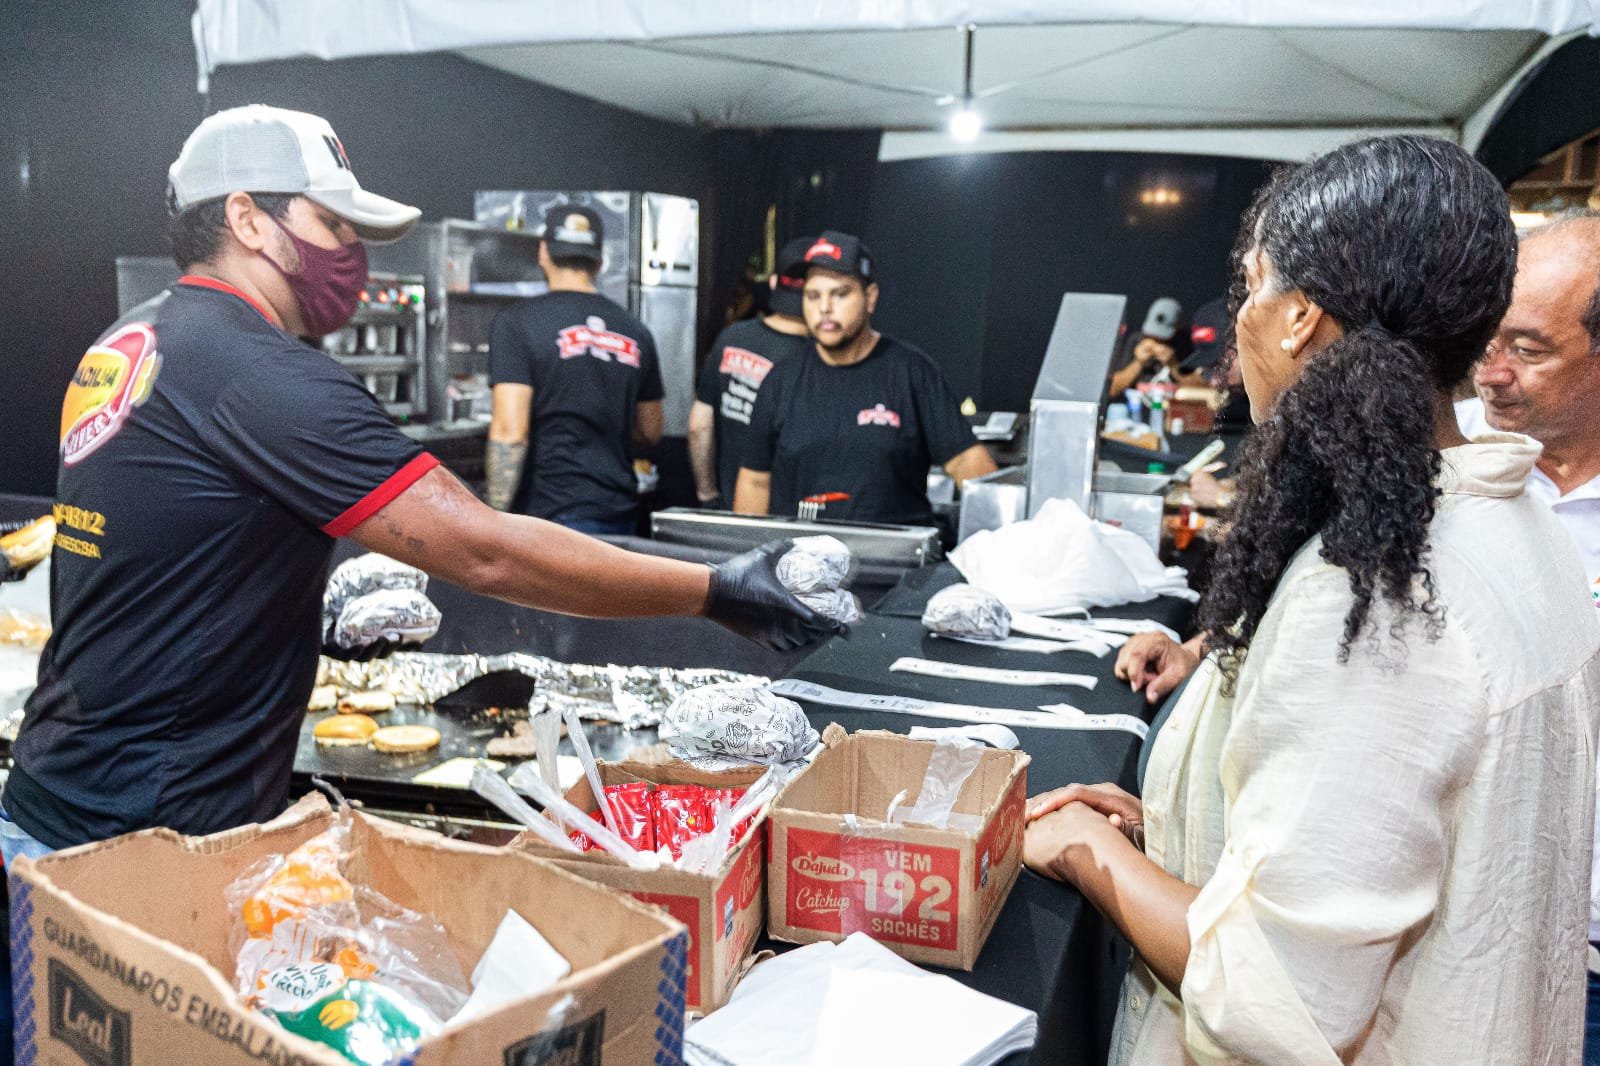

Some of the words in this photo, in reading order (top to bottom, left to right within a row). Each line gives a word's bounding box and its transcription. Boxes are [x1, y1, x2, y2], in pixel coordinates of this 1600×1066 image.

[884, 849, 931, 872] VEM
[796, 886, 850, 918] Catchup
[859, 868, 952, 923] 192
[871, 917, 940, 941] SACHÊS
[43, 916, 183, 1012] GUARDANAPOS
